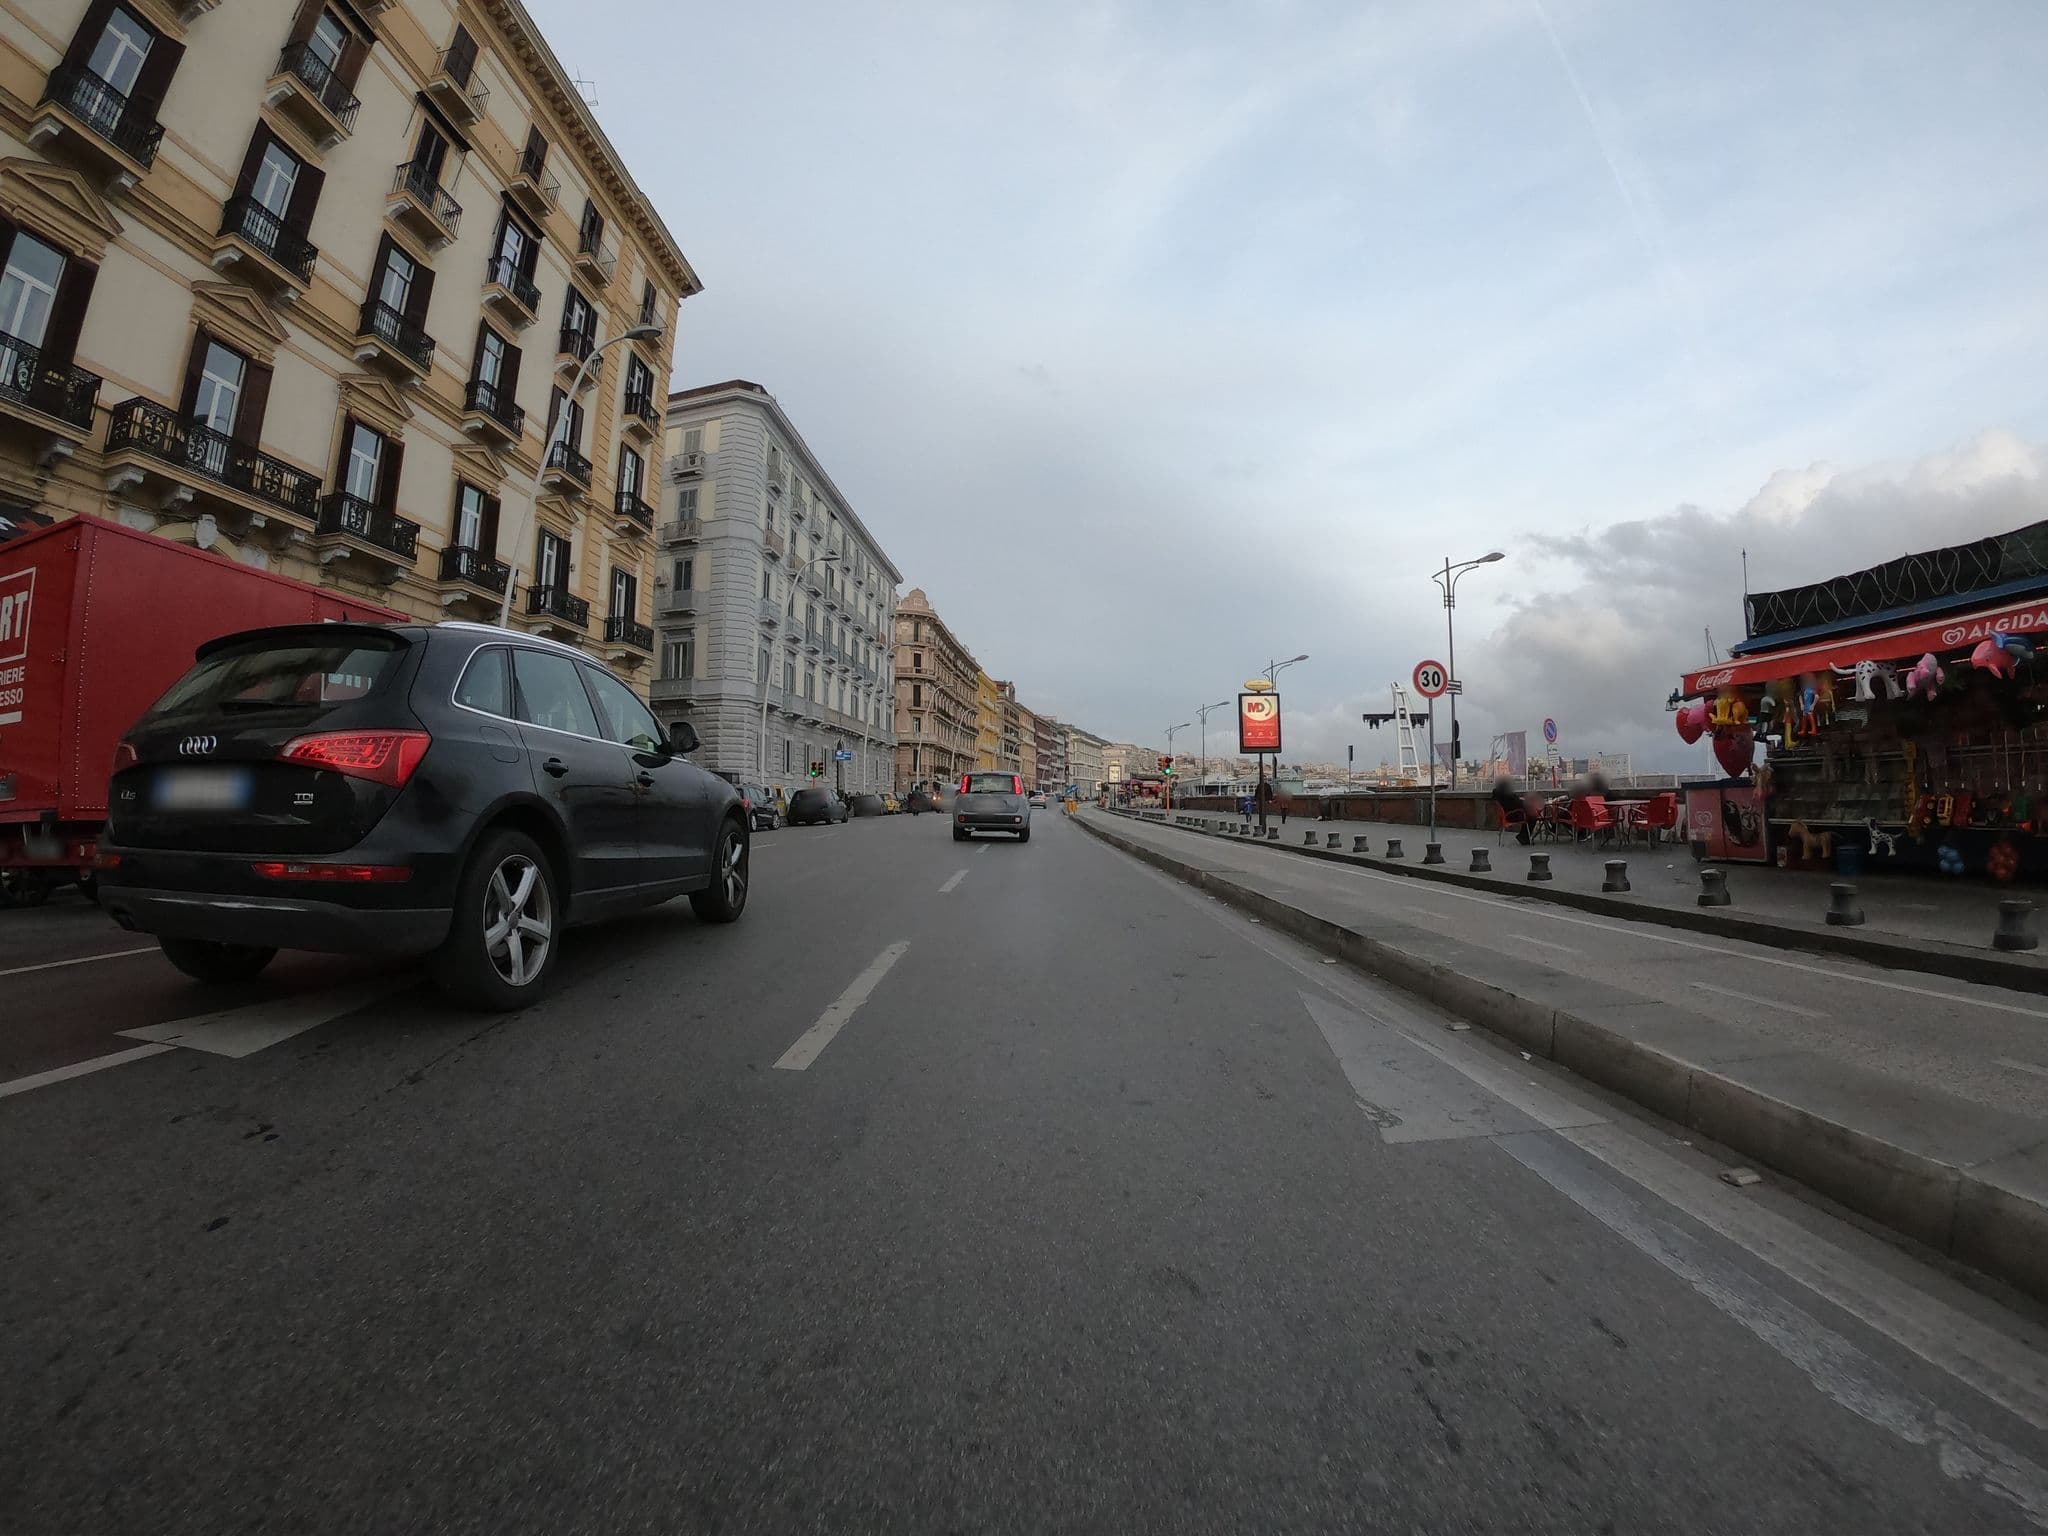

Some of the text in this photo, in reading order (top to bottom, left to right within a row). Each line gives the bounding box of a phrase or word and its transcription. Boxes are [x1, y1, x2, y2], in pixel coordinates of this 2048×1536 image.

[1968, 610, 2048, 640] ALGIDA
[1421, 670, 1441, 688] 30
[294, 792, 314, 801] TDI
